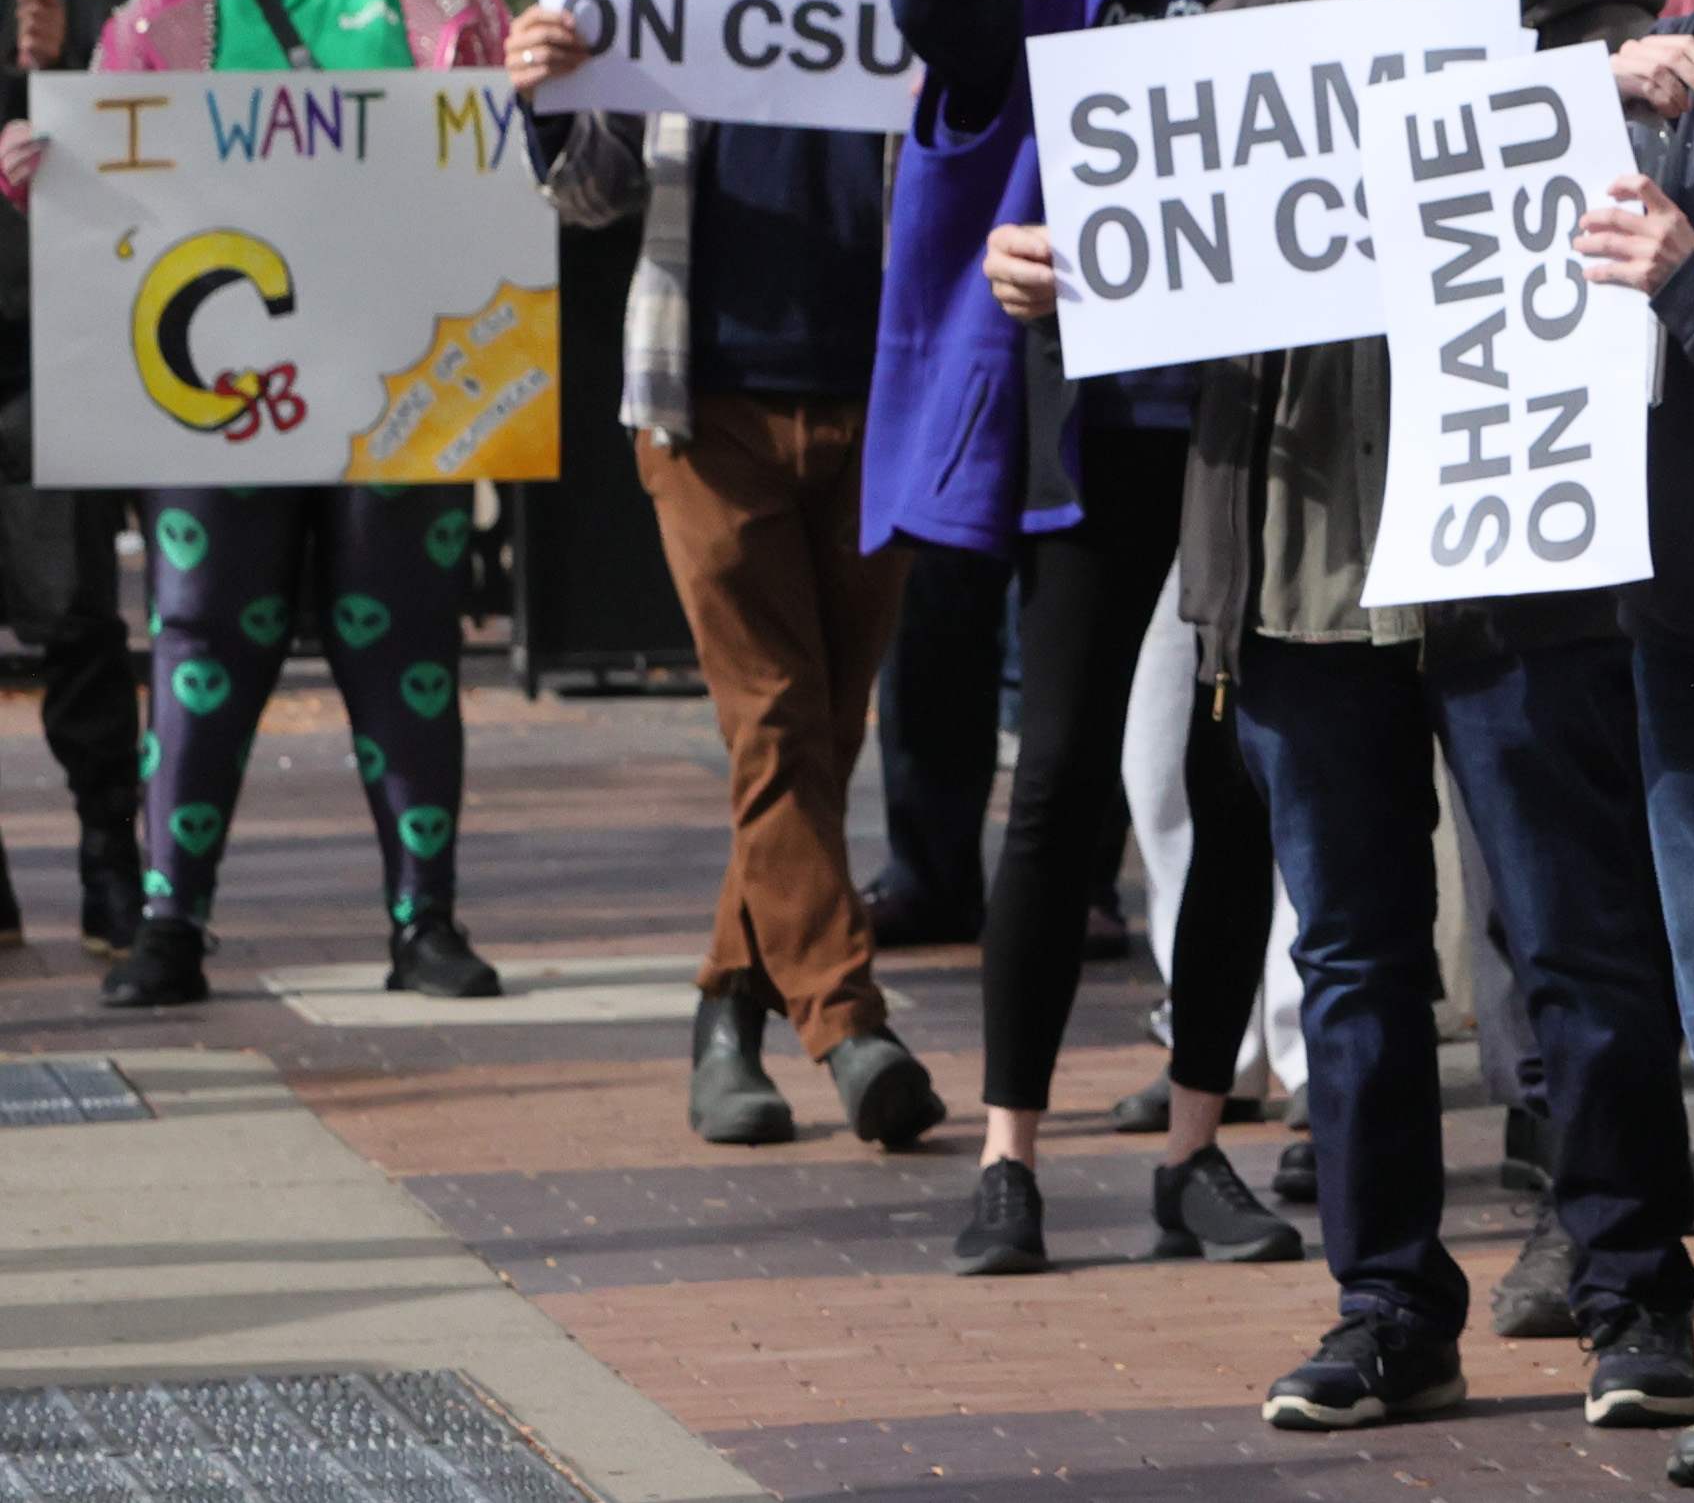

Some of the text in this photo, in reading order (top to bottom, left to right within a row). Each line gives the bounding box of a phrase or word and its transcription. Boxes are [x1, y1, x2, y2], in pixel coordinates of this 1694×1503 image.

[96, 84, 518, 176] I WANT MY
[1078, 191, 1235, 302] ON
[1405, 101, 1512, 568] SHAME
[1488, 82, 1597, 564] ON CSU
